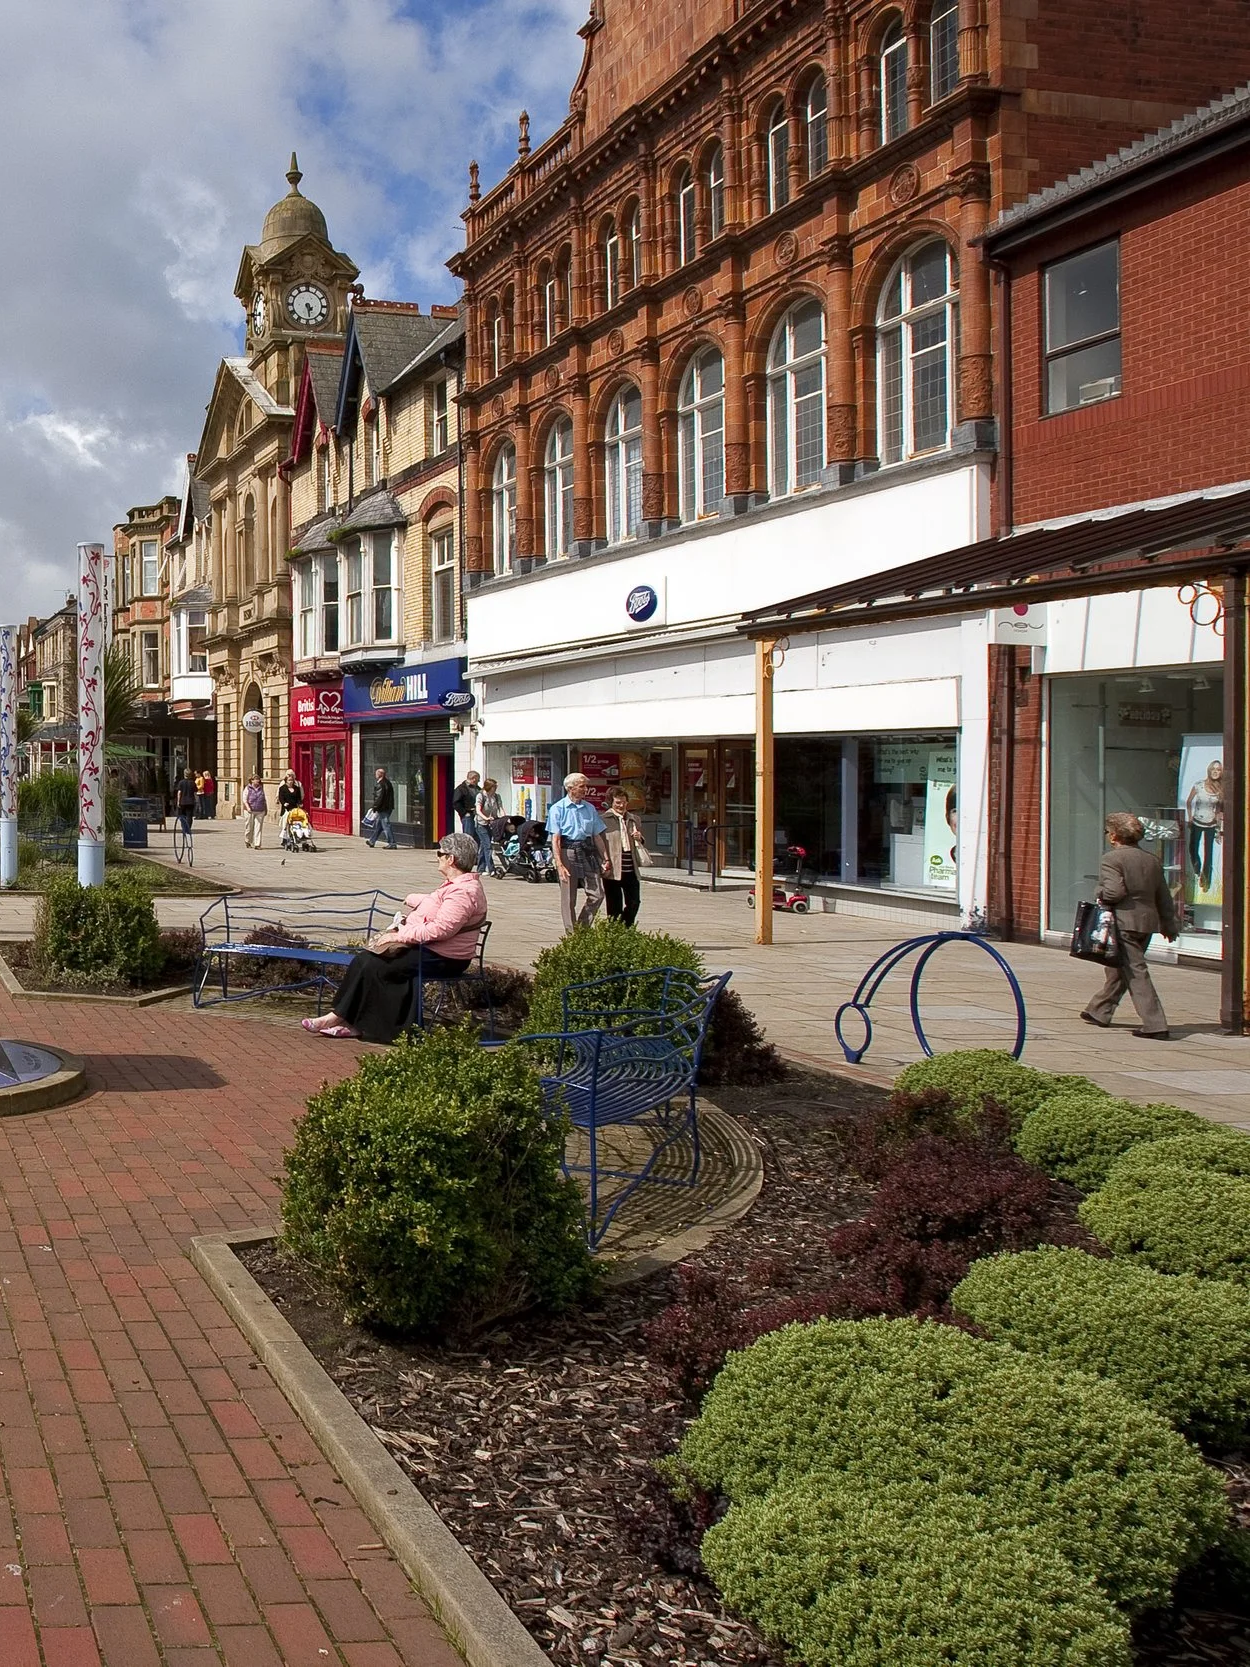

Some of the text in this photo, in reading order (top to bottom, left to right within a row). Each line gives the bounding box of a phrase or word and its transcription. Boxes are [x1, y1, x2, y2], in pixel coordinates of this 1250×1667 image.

[628, 590, 650, 614] Boots
[370, 673, 428, 705] William HILL
[297, 697, 315, 713] Britis
[442, 692, 471, 707] Boots
[245, 720, 264, 728] HSBC
[299, 714, 315, 727] Foun
[583, 754, 597, 764] 1/2
[538, 767, 550, 778] free
[929, 865, 957, 875] Pharma
